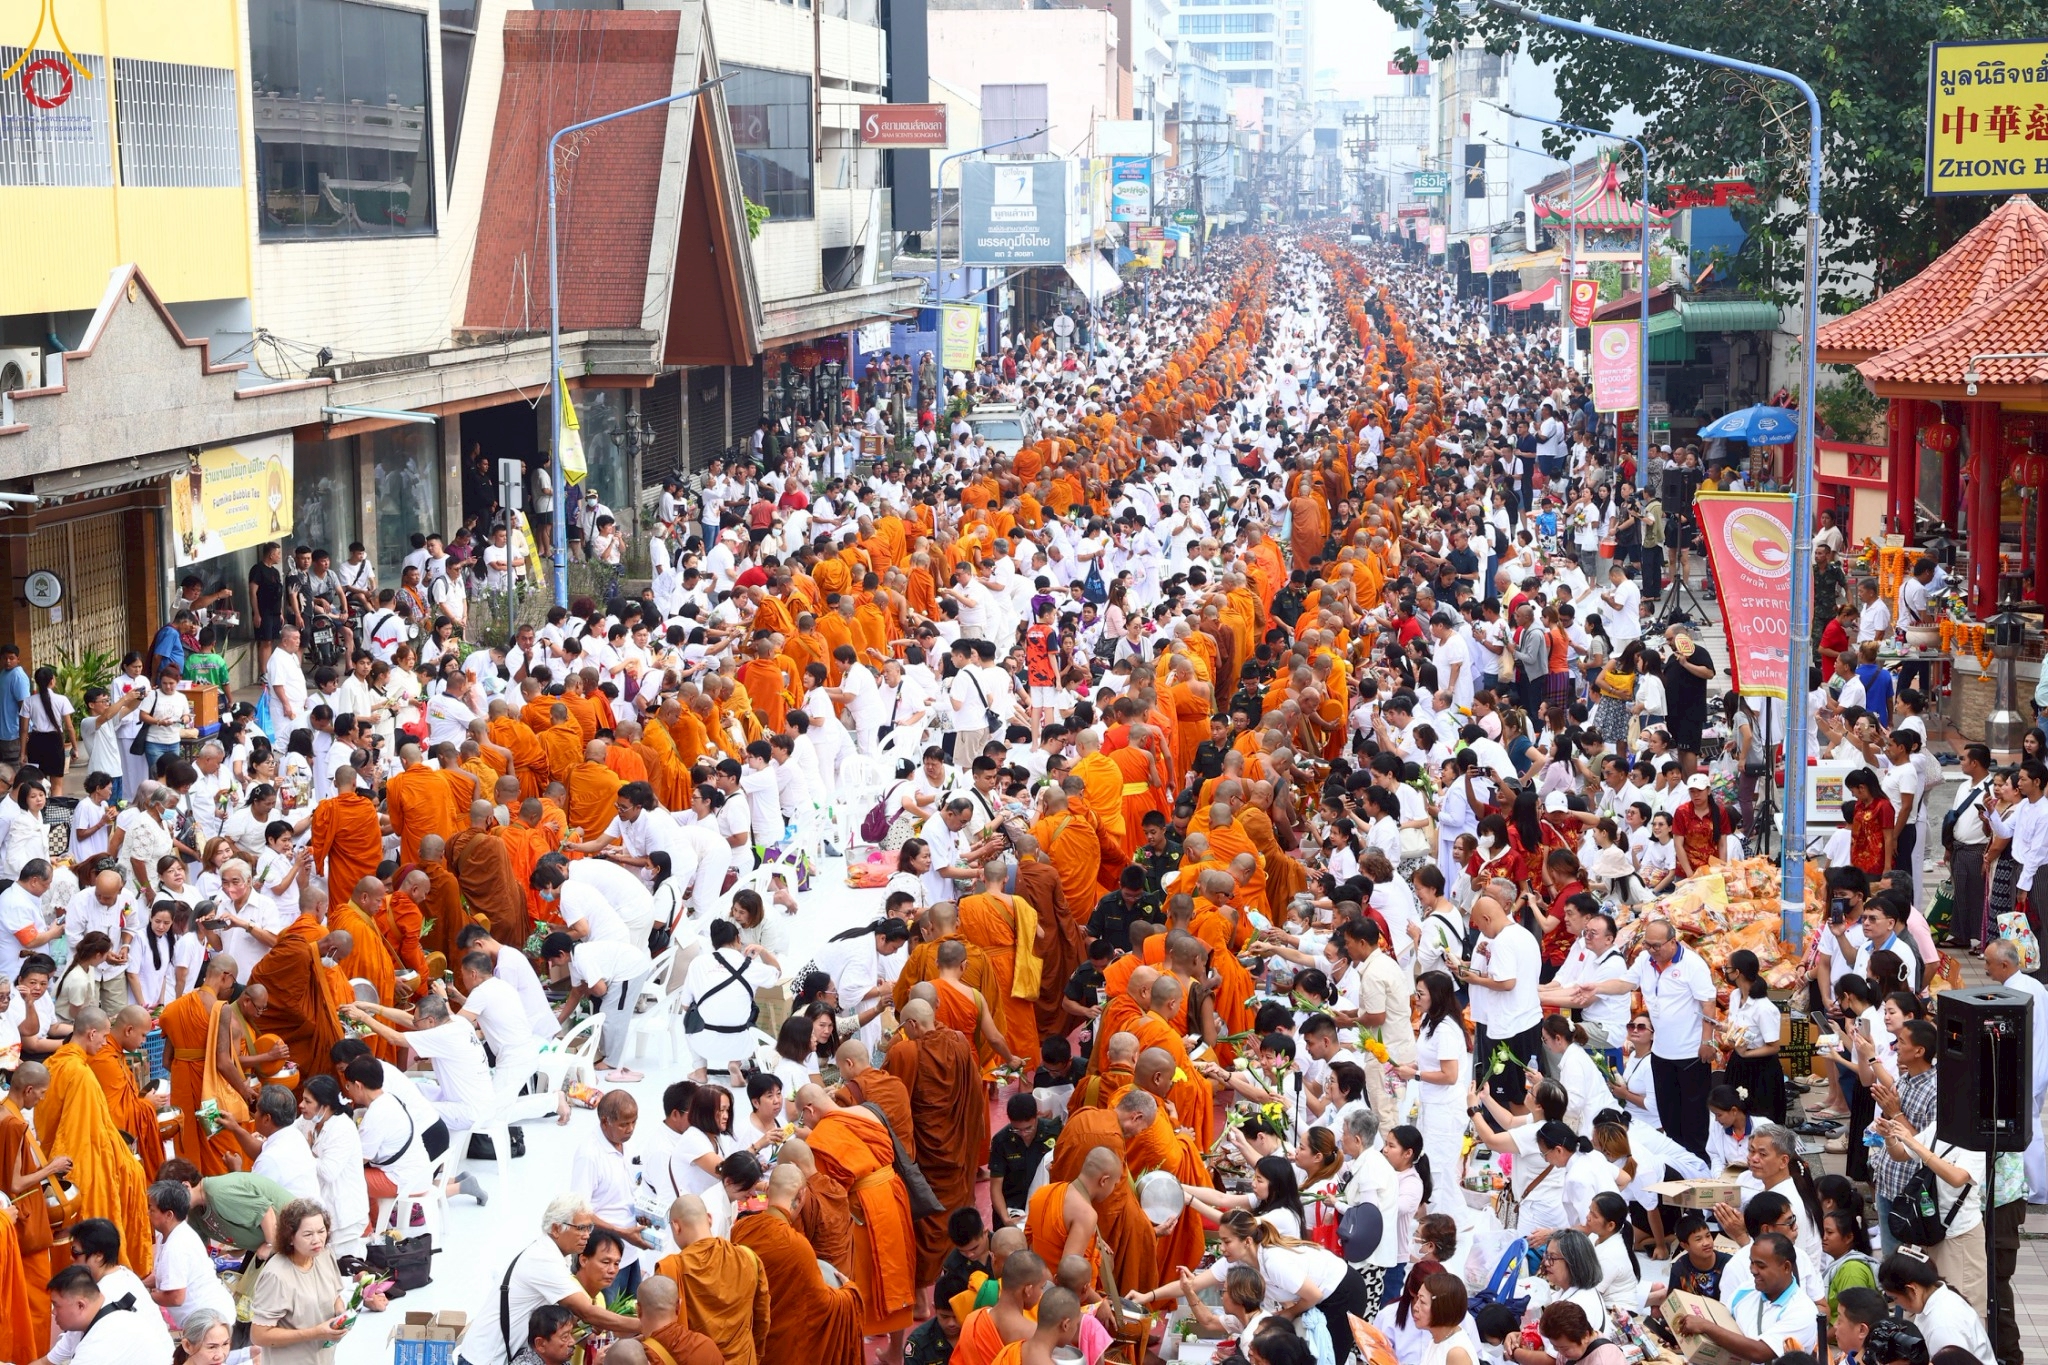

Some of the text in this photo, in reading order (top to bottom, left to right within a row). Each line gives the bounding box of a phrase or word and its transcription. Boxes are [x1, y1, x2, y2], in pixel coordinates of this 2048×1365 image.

[1940, 53, 2048, 95] มูลนิธิจงฮั
[1938, 158, 2026, 178] ZHONG
[977, 233, 1051, 250] พรรคภูมิใจไทย
[212, 488, 260, 509] Fumiko Bubble Tea
[1999, 1023, 2006, 1032] 6
